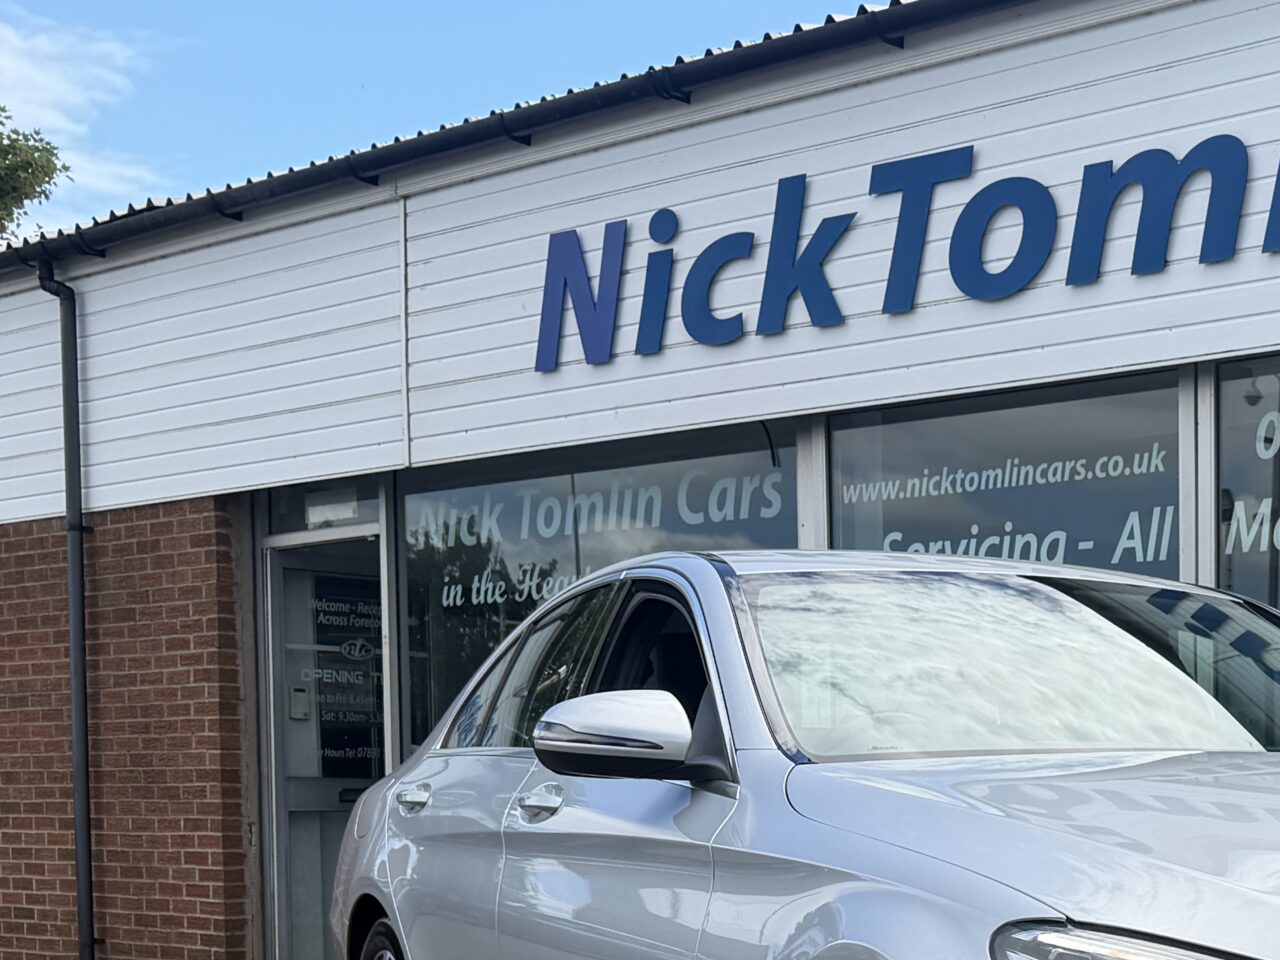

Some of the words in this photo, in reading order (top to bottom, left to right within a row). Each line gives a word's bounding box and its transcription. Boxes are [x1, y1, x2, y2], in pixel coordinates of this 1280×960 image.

[842, 442, 1167, 505] www.nicktomlincars.co.uk
[416, 491, 505, 550] Nick
[516, 474, 662, 542] Tomlin
[677, 466, 783, 525] Cars
[883, 520, 1067, 564] icing
[1112, 505, 1174, 564] All
[442, 576, 465, 608] in
[471, 567, 508, 606] the
[515, 564, 592, 603] Hea
[301, 669, 363, 685] OPENING
